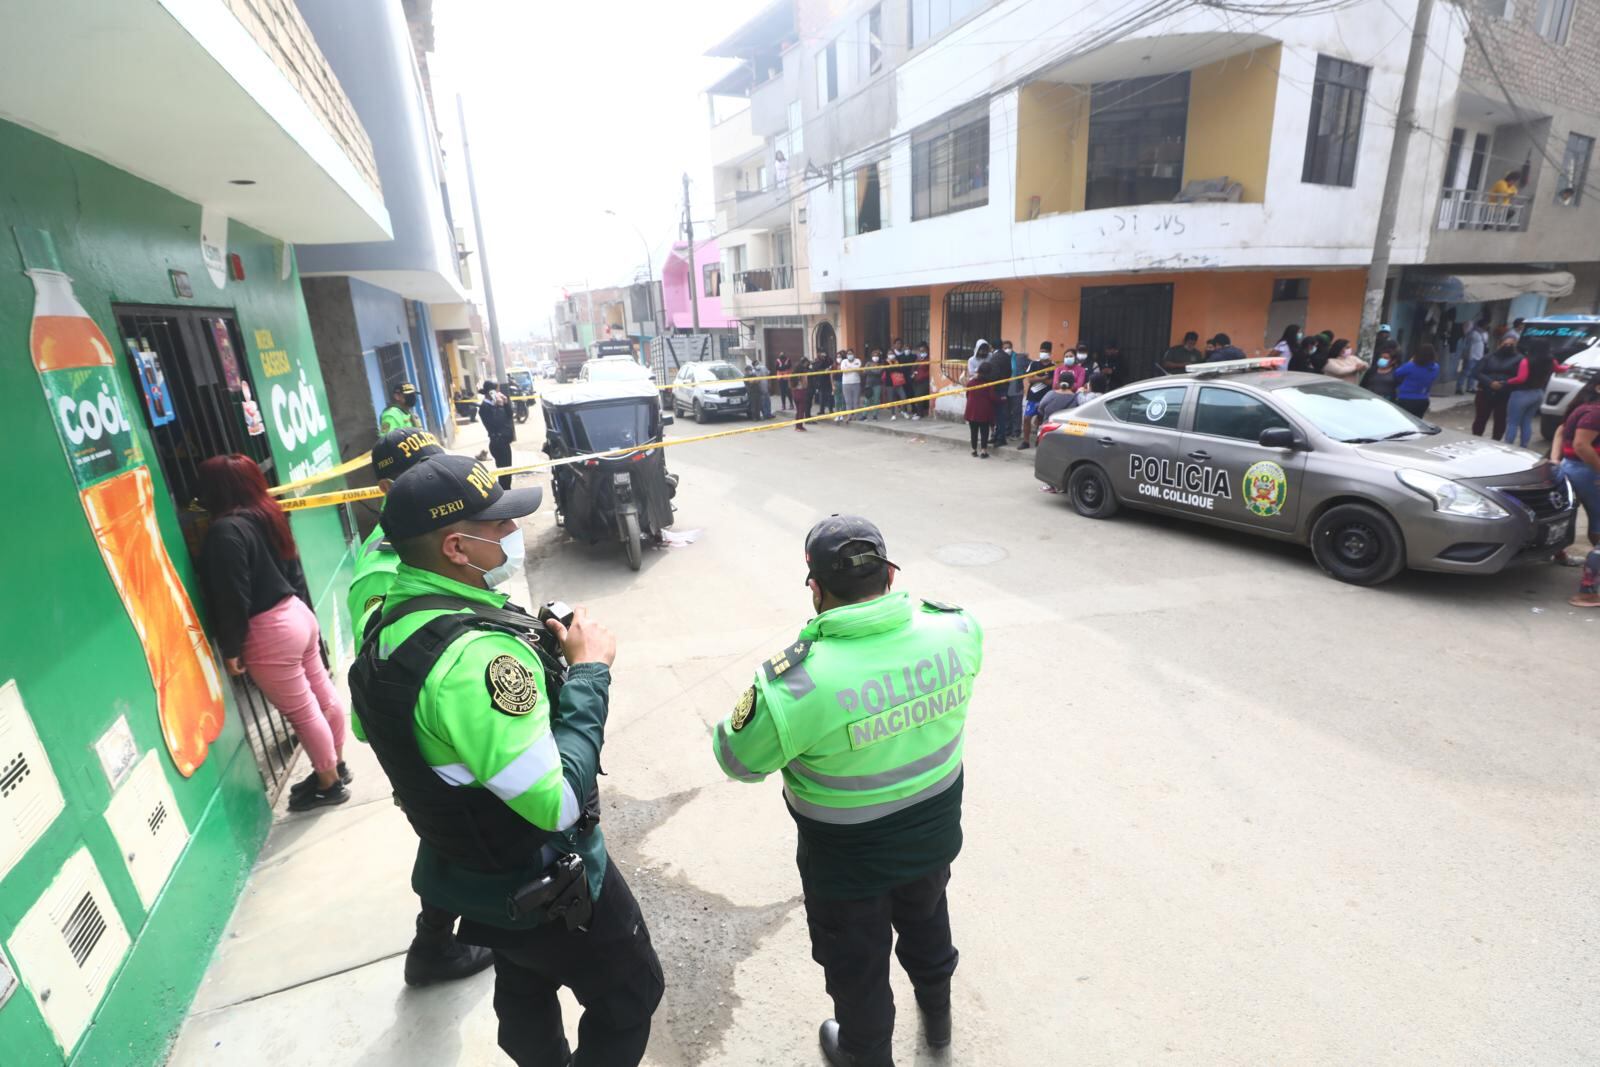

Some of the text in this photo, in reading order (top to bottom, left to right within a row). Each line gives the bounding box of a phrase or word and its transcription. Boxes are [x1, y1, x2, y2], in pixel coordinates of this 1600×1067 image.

[378, 456, 394, 470] PERU
[1129, 453, 1232, 499] POLICIA
[342, 488, 367, 500] ZONA
[1138, 483, 1215, 510] COM. COLLIQUE
[428, 499, 465, 519] PERU
[835, 646, 966, 715] POLICIA
[853, 684, 966, 746] NACIONAL
